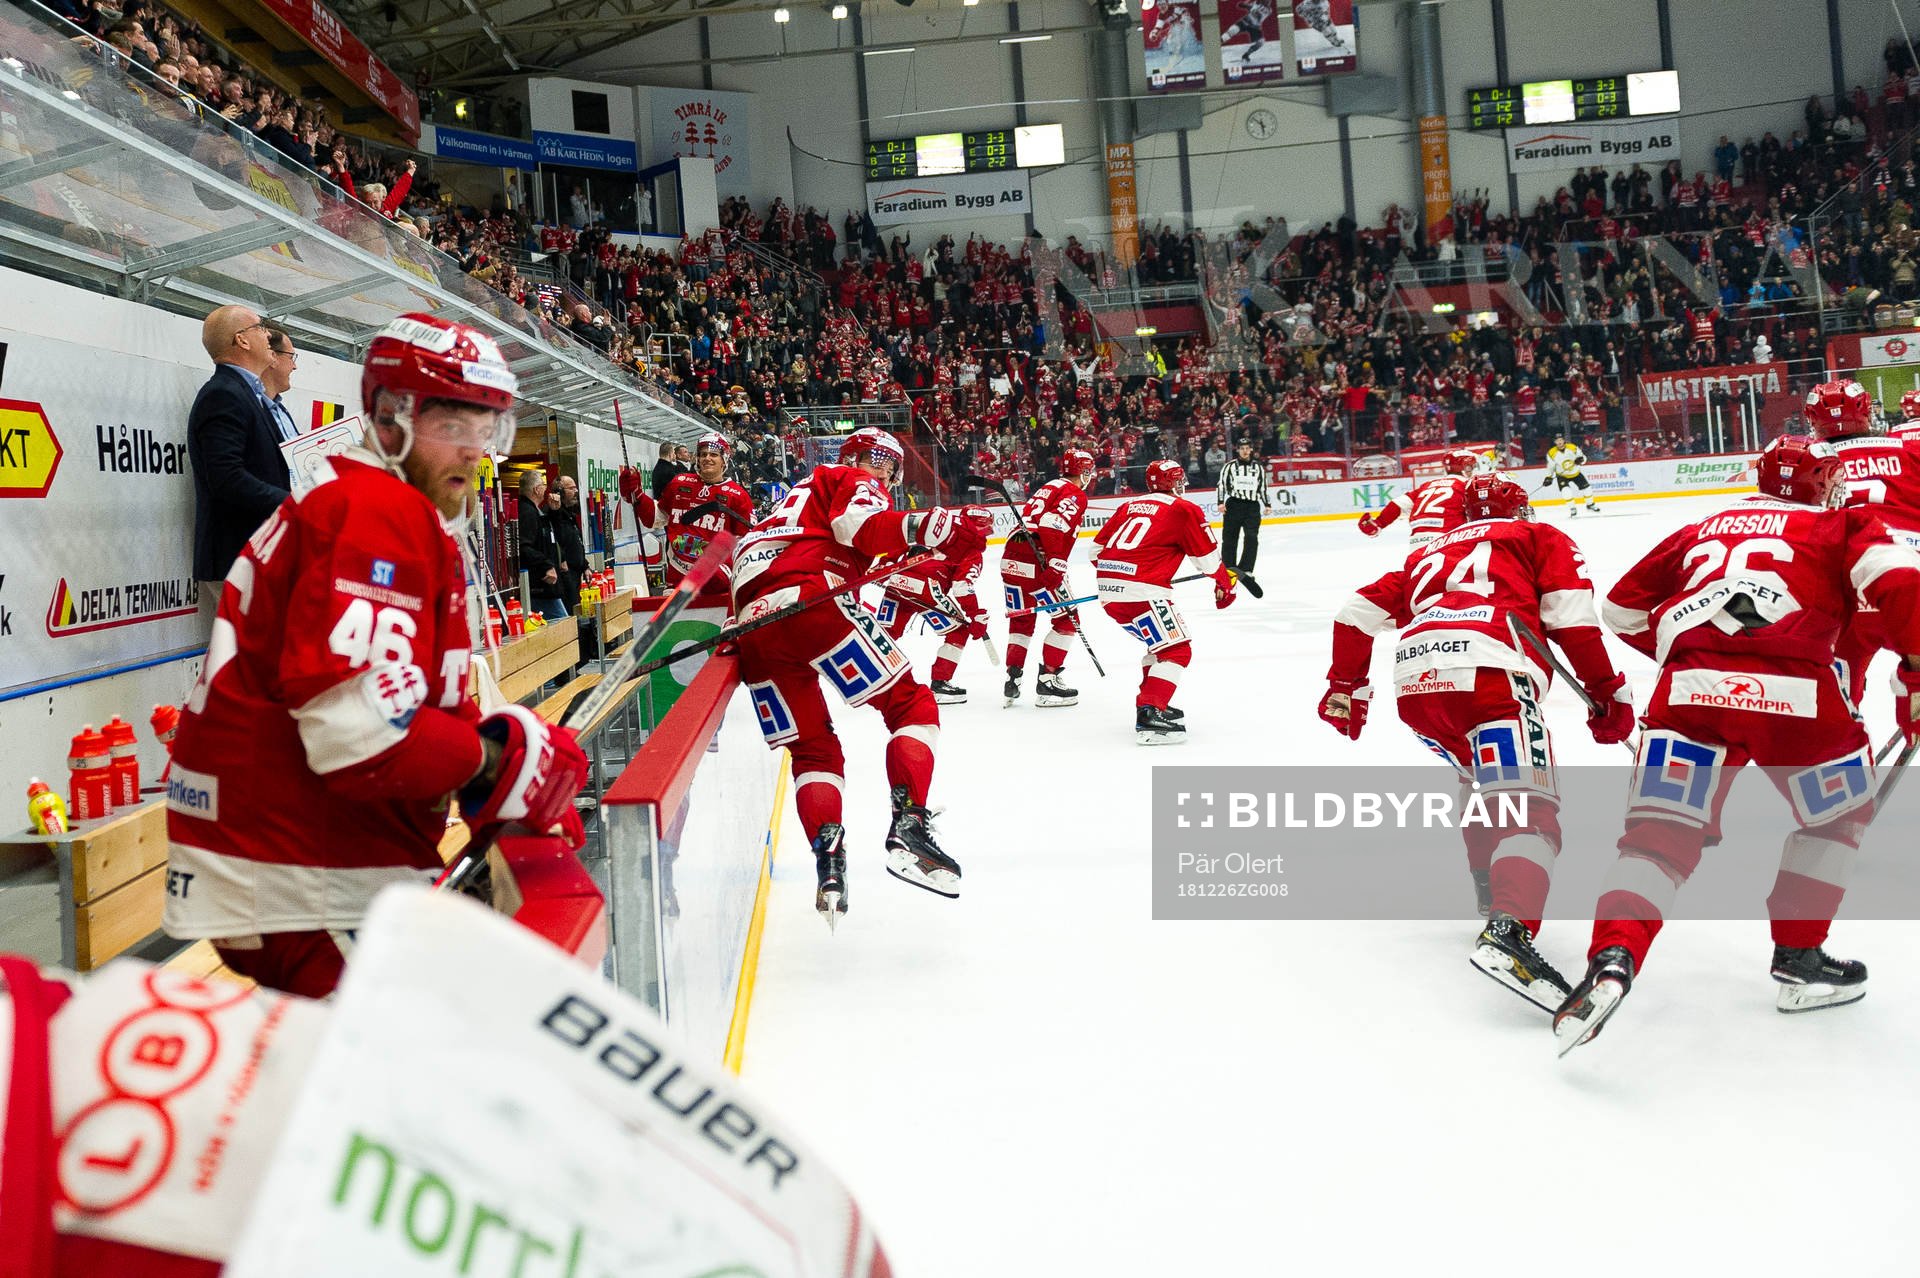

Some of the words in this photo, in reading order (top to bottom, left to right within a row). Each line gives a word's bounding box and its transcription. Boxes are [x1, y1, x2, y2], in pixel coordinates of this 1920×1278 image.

[1473, 92, 1480, 101] A
[1576, 83, 1584, 92] D
[1473, 105, 1480, 113] B
[1577, 96, 1584, 104] E
[674, 99, 711, 121] TIMRÅ
[713, 108, 728, 125] IK
[1577, 109, 1584, 117] F
[1474, 118, 1482, 126] C
[438, 135, 488, 153] Välkommen
[489, 145, 497, 155] in
[502, 148, 533, 161] värmen
[869, 144, 877, 153] A
[968, 136, 975, 144] D
[1515, 143, 1592, 160] Faradium
[1600, 140, 1642, 154] Bygg
[1648, 135, 1673, 148] AB
[544, 148, 556, 157] AB
[557, 148, 579, 160] KARL
[579, 151, 605, 162] HEDIN
[607, 153, 632, 165] logen
[870, 157, 877, 166] B
[969, 148, 975, 156] E
[871, 169, 878, 177] C
[970, 160, 976, 168] F
[874, 197, 948, 214] Faradium
[955, 194, 995, 208] Bygg
[1000, 190, 1024, 203] AB
[96, 423, 187, 475] Hållbar
[1676, 461, 1743, 476] Byberg
[1842, 456, 1902, 479] EGARD
[1686, 474, 1726, 484] Nordin
[1351, 483, 1395, 509] NHK
[1780, 484, 1793, 496] 26
[1057, 500, 1078, 521] 52
[1126, 503, 1160, 516] PERSSON
[1412, 487, 1454, 517] 72
[1480, 506, 1491, 516] 24
[671, 507, 726, 532] TRÅ
[1697, 513, 1789, 540] LARSSON
[1106, 516, 1153, 550] 10
[371, 560, 395, 585] ST
[1682, 537, 1795, 592] 26
[1409, 540, 1496, 616] 24
[81, 587, 121, 623] DELTA
[125, 579, 182, 616] TERMINAL
[185, 576, 199, 606] AB
[328, 598, 417, 670] 46
[1396, 640, 1471, 664] BILBOLAGET
[1401, 681, 1457, 694] PROLYMPIA
[1690, 692, 1795, 714] PROLYMPIA
